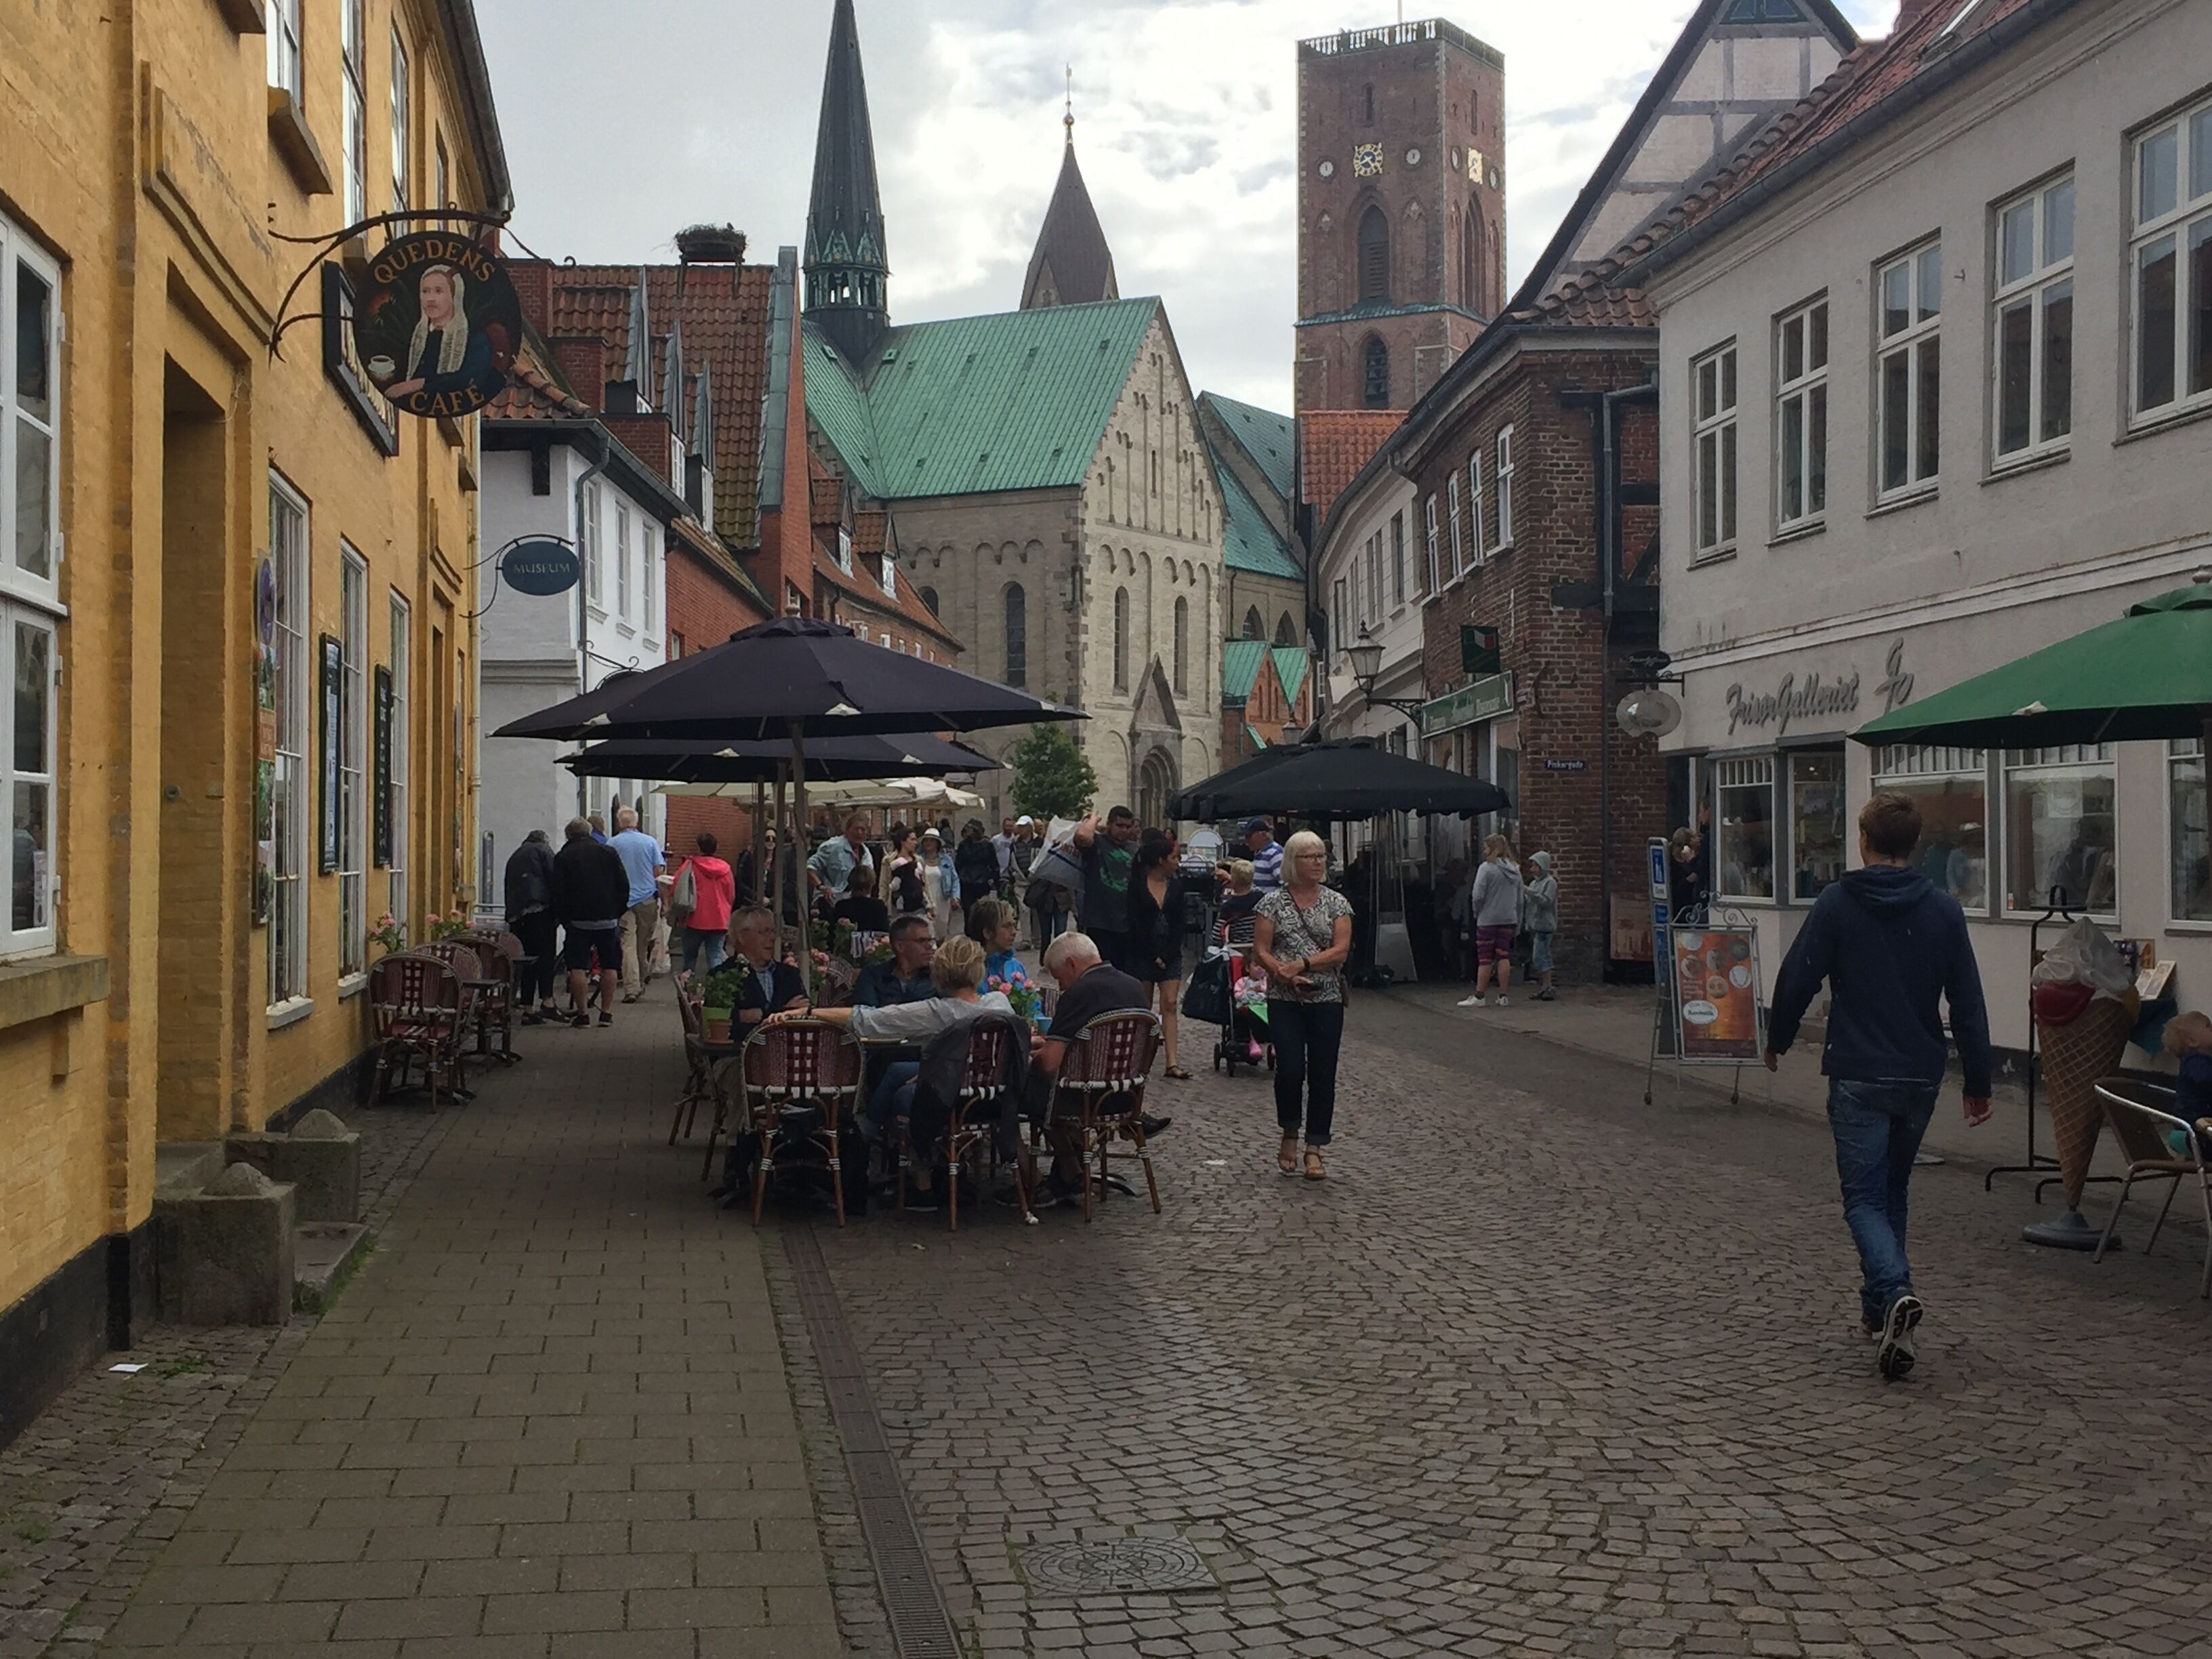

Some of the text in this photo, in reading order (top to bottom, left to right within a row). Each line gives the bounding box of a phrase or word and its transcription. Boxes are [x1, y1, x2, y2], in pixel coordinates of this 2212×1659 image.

[374, 239, 495, 283] QUEDENS
[409, 378, 486, 415] CAFÉ
[514, 563, 570, 573] MUSEUM
